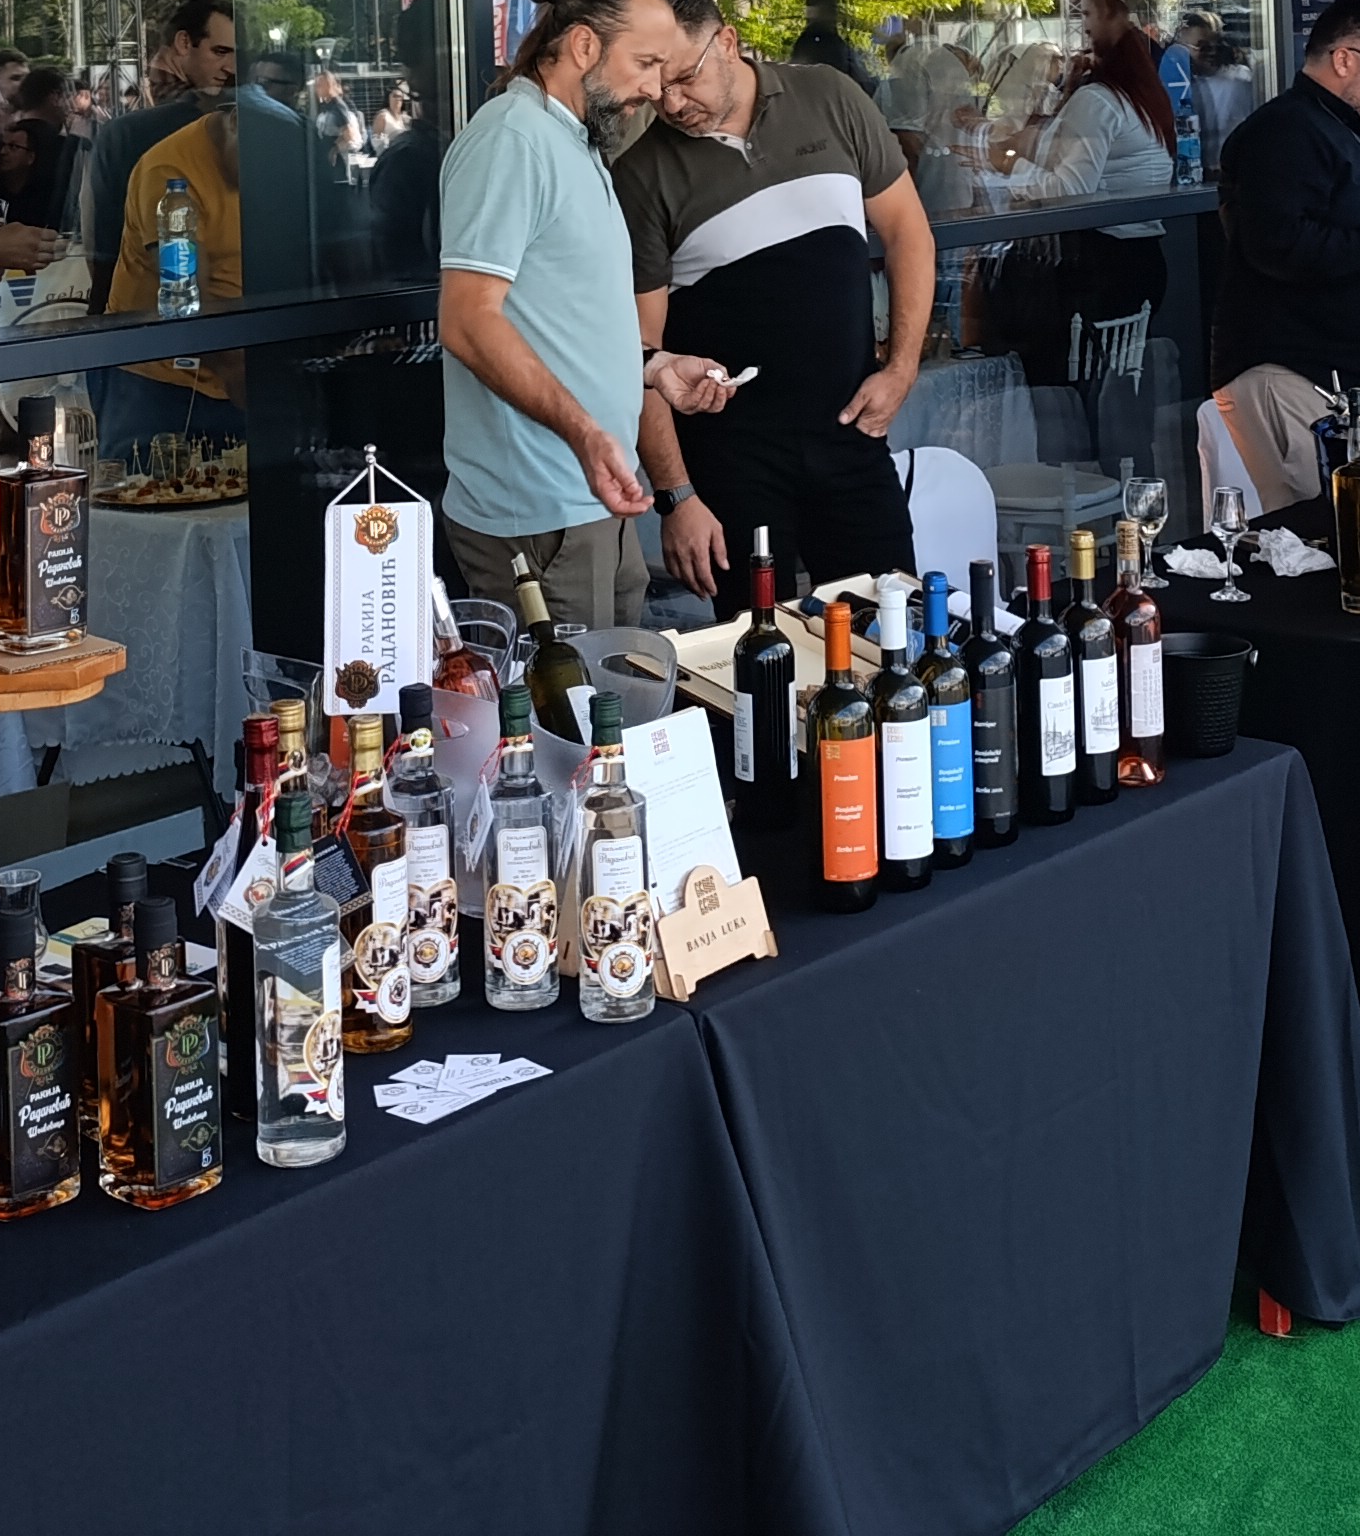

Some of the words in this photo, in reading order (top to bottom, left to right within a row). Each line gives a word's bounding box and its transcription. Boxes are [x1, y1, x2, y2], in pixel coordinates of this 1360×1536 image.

[45, 285, 91, 304] gelat
[362, 589, 375, 654] РАКИЈА
[381, 557, 396, 684] РАДАНОВИЋ
[686, 929, 718, 953] BANJA
[721, 915, 748, 936] LUKA
[29, 1085, 61, 1103] РАКИЈА
[175, 1078, 204, 1095] РАКИЈА
[201, 1148, 213, 1168] 5
